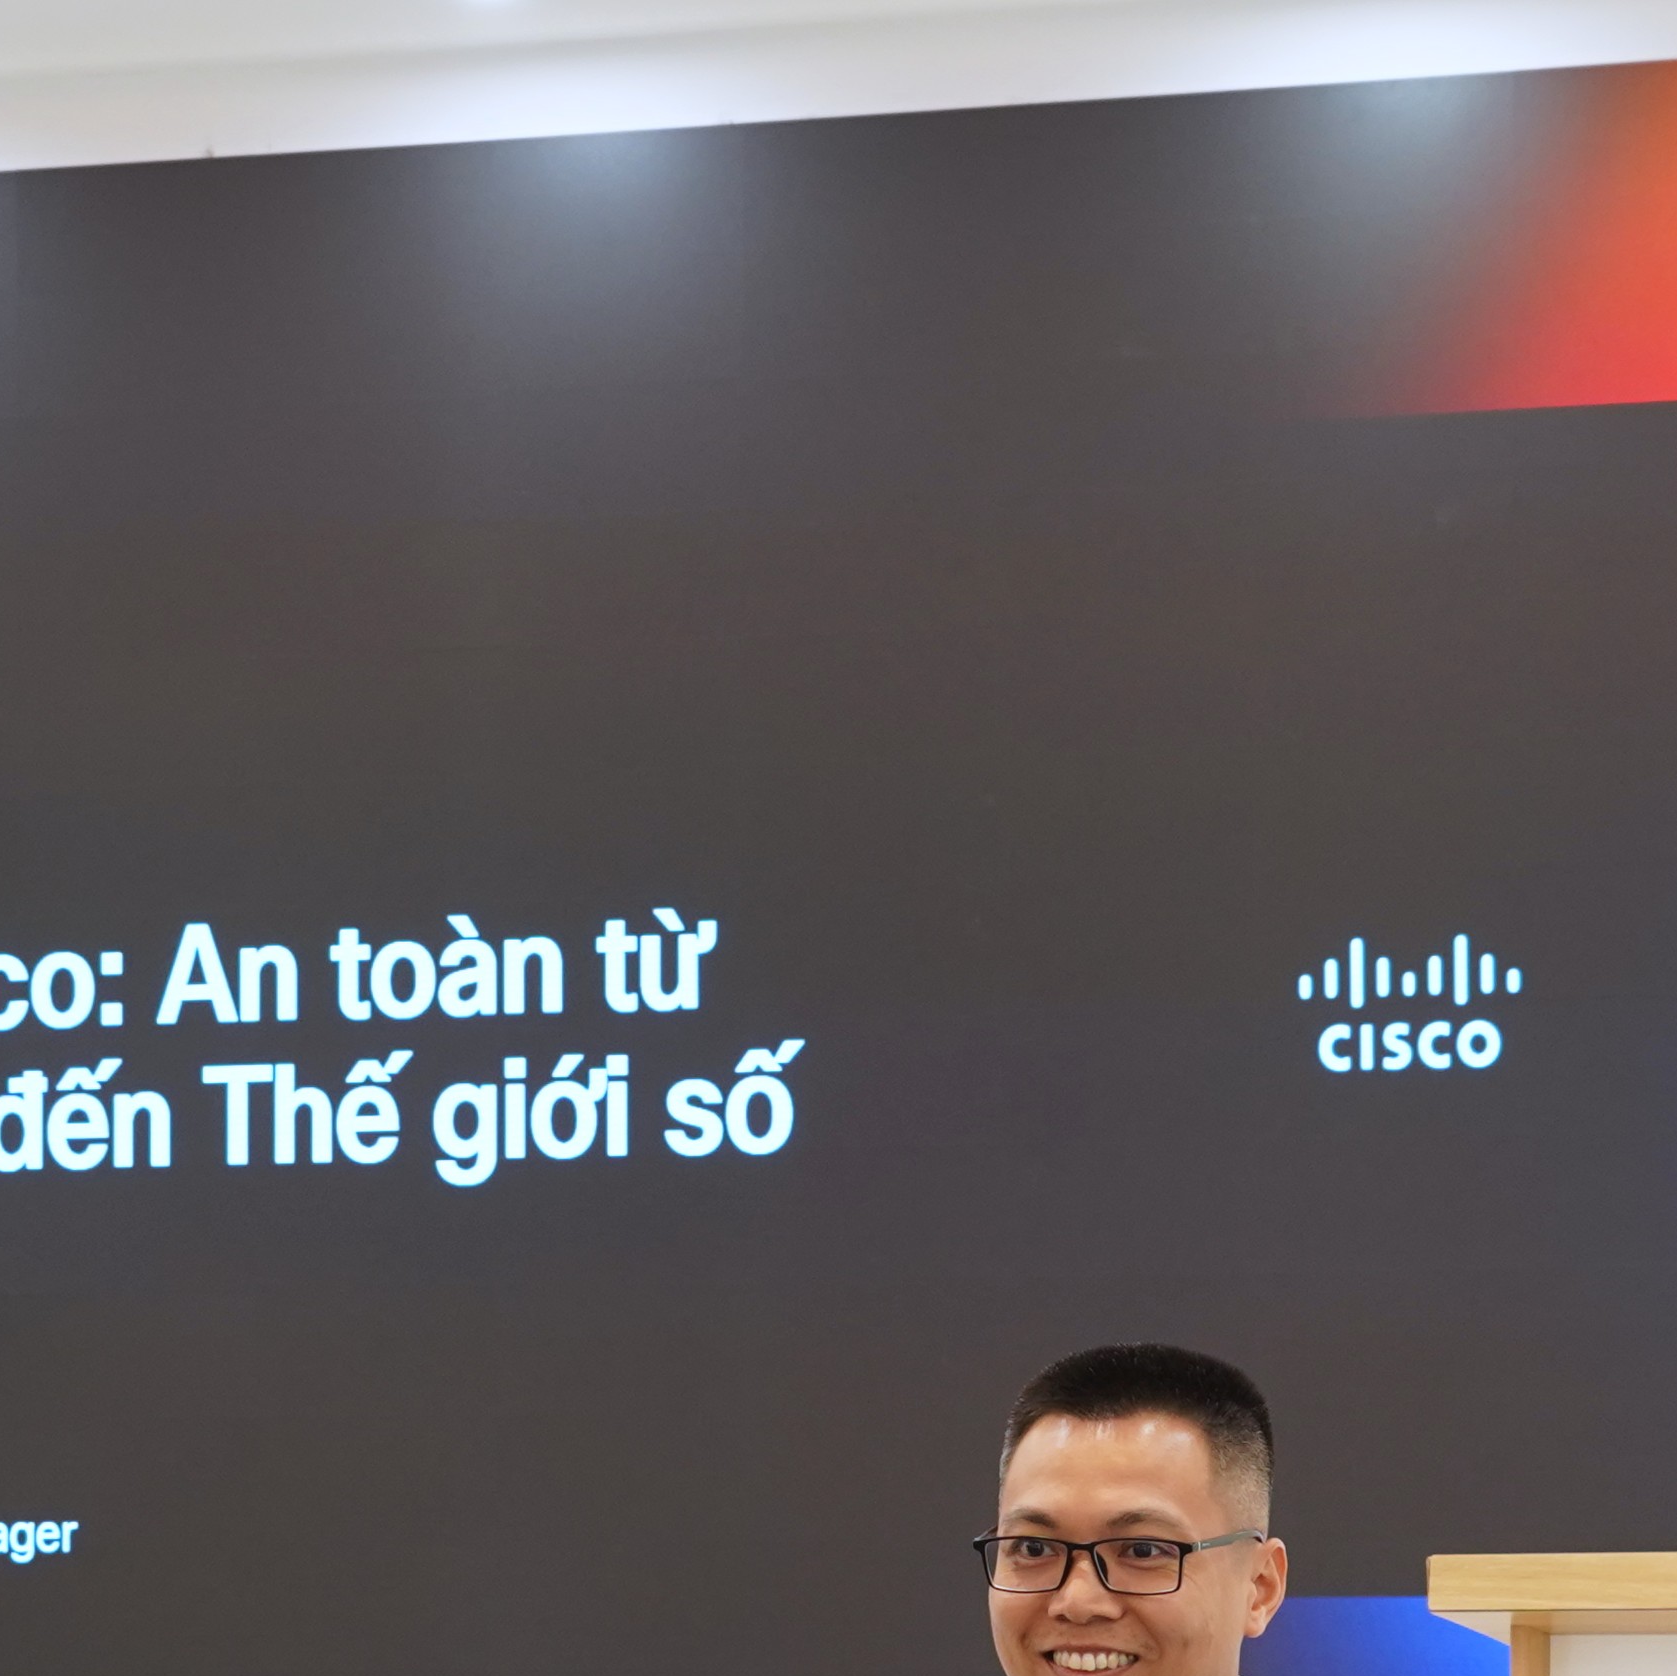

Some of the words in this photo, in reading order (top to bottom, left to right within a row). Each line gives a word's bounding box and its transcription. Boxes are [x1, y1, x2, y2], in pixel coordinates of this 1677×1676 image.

[155, 922, 299, 1025] An
[329, 914, 564, 1021] toàn
[595, 907, 719, 1014] từ
[1317, 1018, 1503, 1073] CISCO
[201, 1049, 414, 1167] Thế
[432, 1053, 630, 1188] giới
[664, 1038, 806, 1157] số
